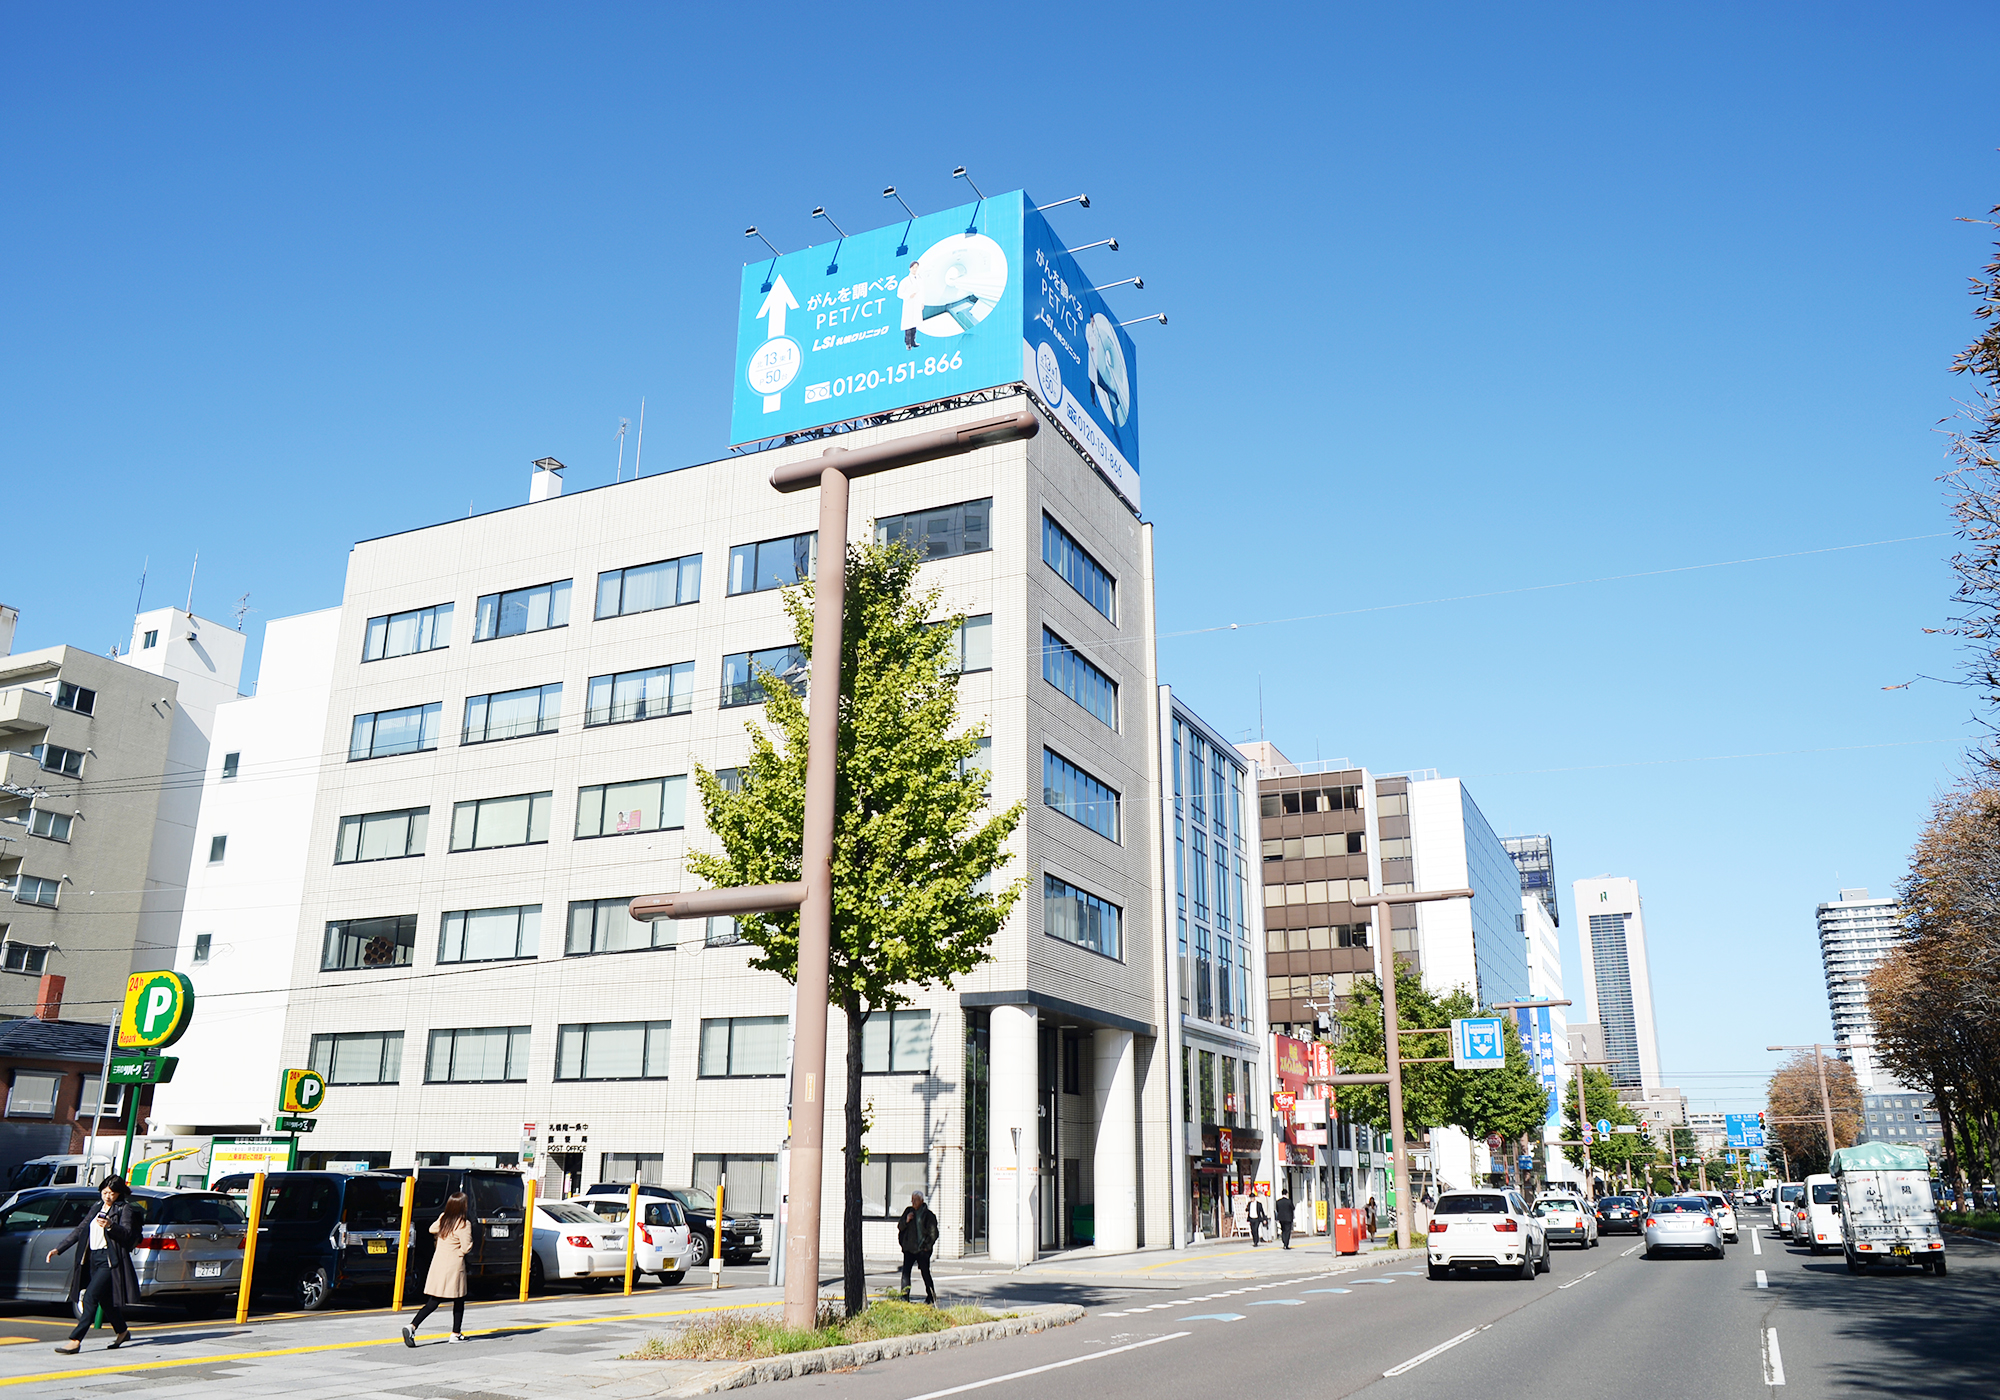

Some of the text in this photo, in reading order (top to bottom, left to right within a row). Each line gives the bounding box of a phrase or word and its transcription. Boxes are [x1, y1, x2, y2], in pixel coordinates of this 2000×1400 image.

[806, 275, 899, 311] がんを調べる
[1036, 248, 1083, 321] がんを調べる
[816, 298, 886, 330] PET/CT
[1042, 278, 1078, 337] PET/CT
[812, 335, 836, 352] LSI
[832, 350, 963, 397] 0120-151-866
[1078, 415, 1124, 478] 0120-151-866
[143, 987, 173, 1033] P
[120, 1032, 137, 1045] Repark
[302, 1079, 320, 1105] P
